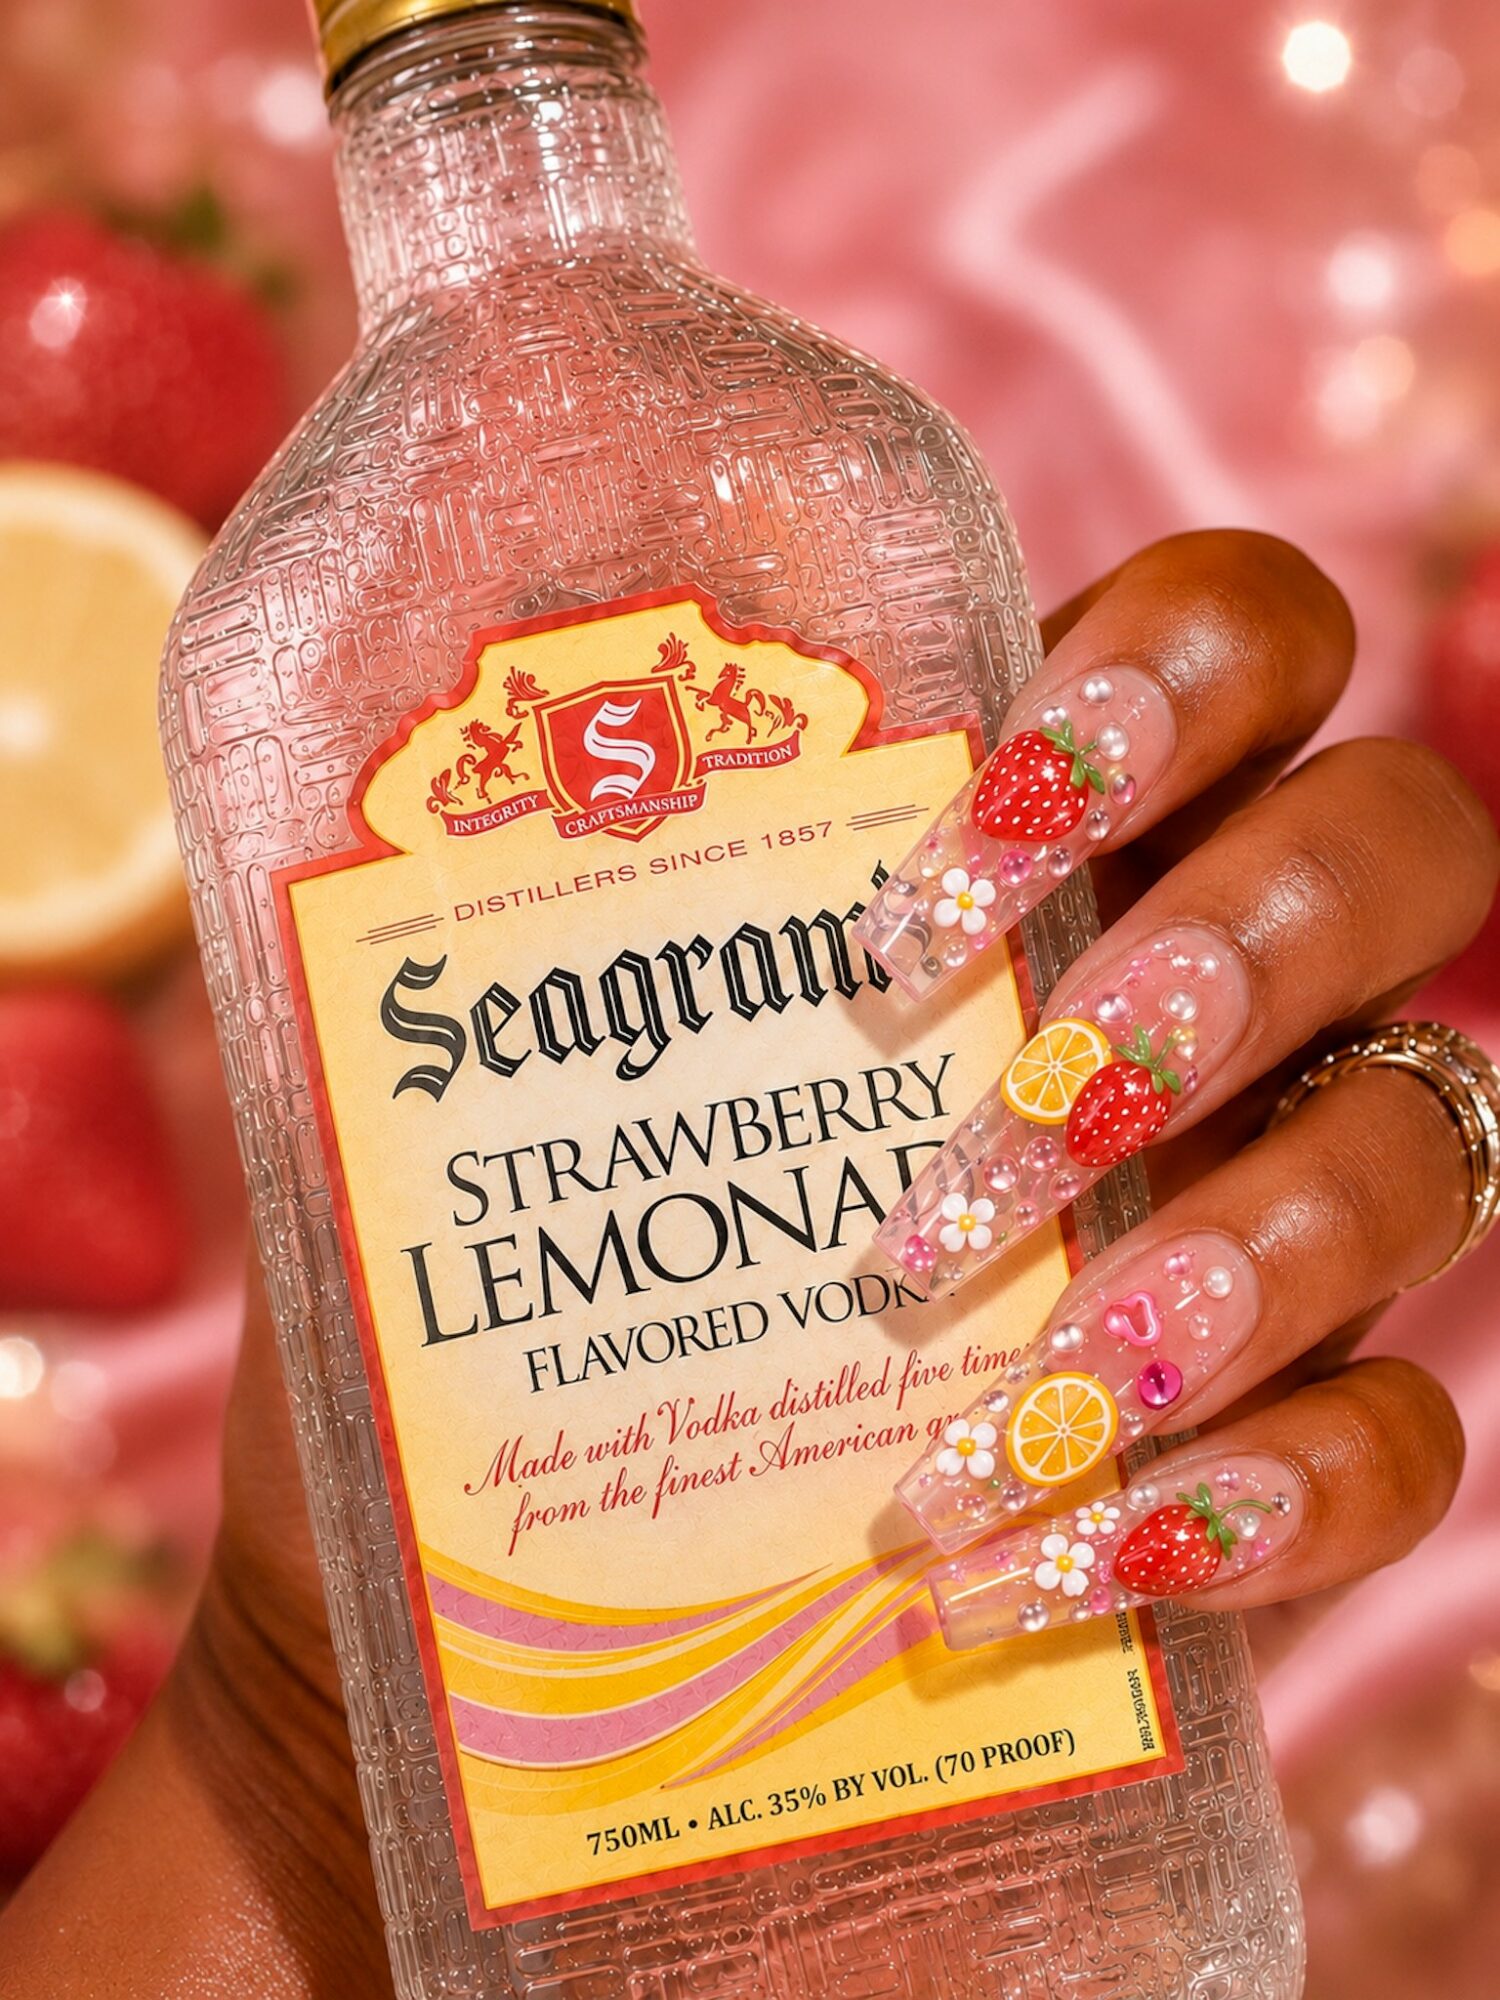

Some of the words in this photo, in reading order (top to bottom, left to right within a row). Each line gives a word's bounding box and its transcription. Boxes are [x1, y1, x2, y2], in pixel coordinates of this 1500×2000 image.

[452, 794, 539, 834] INTEGRITY
[564, 793, 699, 836] CRAFTSMANSHIP
[583, 698, 656, 803] S
[702, 744, 793, 770] TRADITION
[453, 863, 638, 922] DISTILLERS
[650, 839, 748, 876] SINCE
[762, 820, 833, 851] 1857
[379, 859, 895, 1103] Seagram'
[445, 1052, 957, 1227] STRAWBERRY
[400, 1140, 976, 1348] LEMONAD
[522, 1298, 770, 1394] FLAVORED
[777, 1266, 956, 1331] VODK
[463, 1429, 578, 1496] Made
[584, 1412, 655, 1464] with
[657, 1390, 762, 1446] Vodka
[768, 1355, 892, 1420] distilled
[895, 1348, 955, 1411] five
[961, 1342, 1030, 1377] time
[507, 1491, 591, 1557] from
[599, 1466, 648, 1512] the
[651, 1451, 743, 1520] finest
[749, 1421, 919, 1477] American
[585, 1815, 681, 1856] 750ML
[707, 1795, 763, 1830] ALC.
[768, 1785, 827, 1818] 35%
[833, 1772, 865, 1802] BY
[870, 1760, 929, 1792] VOL.
[934, 1748, 977, 1785] (70
[982, 1728, 1077, 1768] PROOF)
